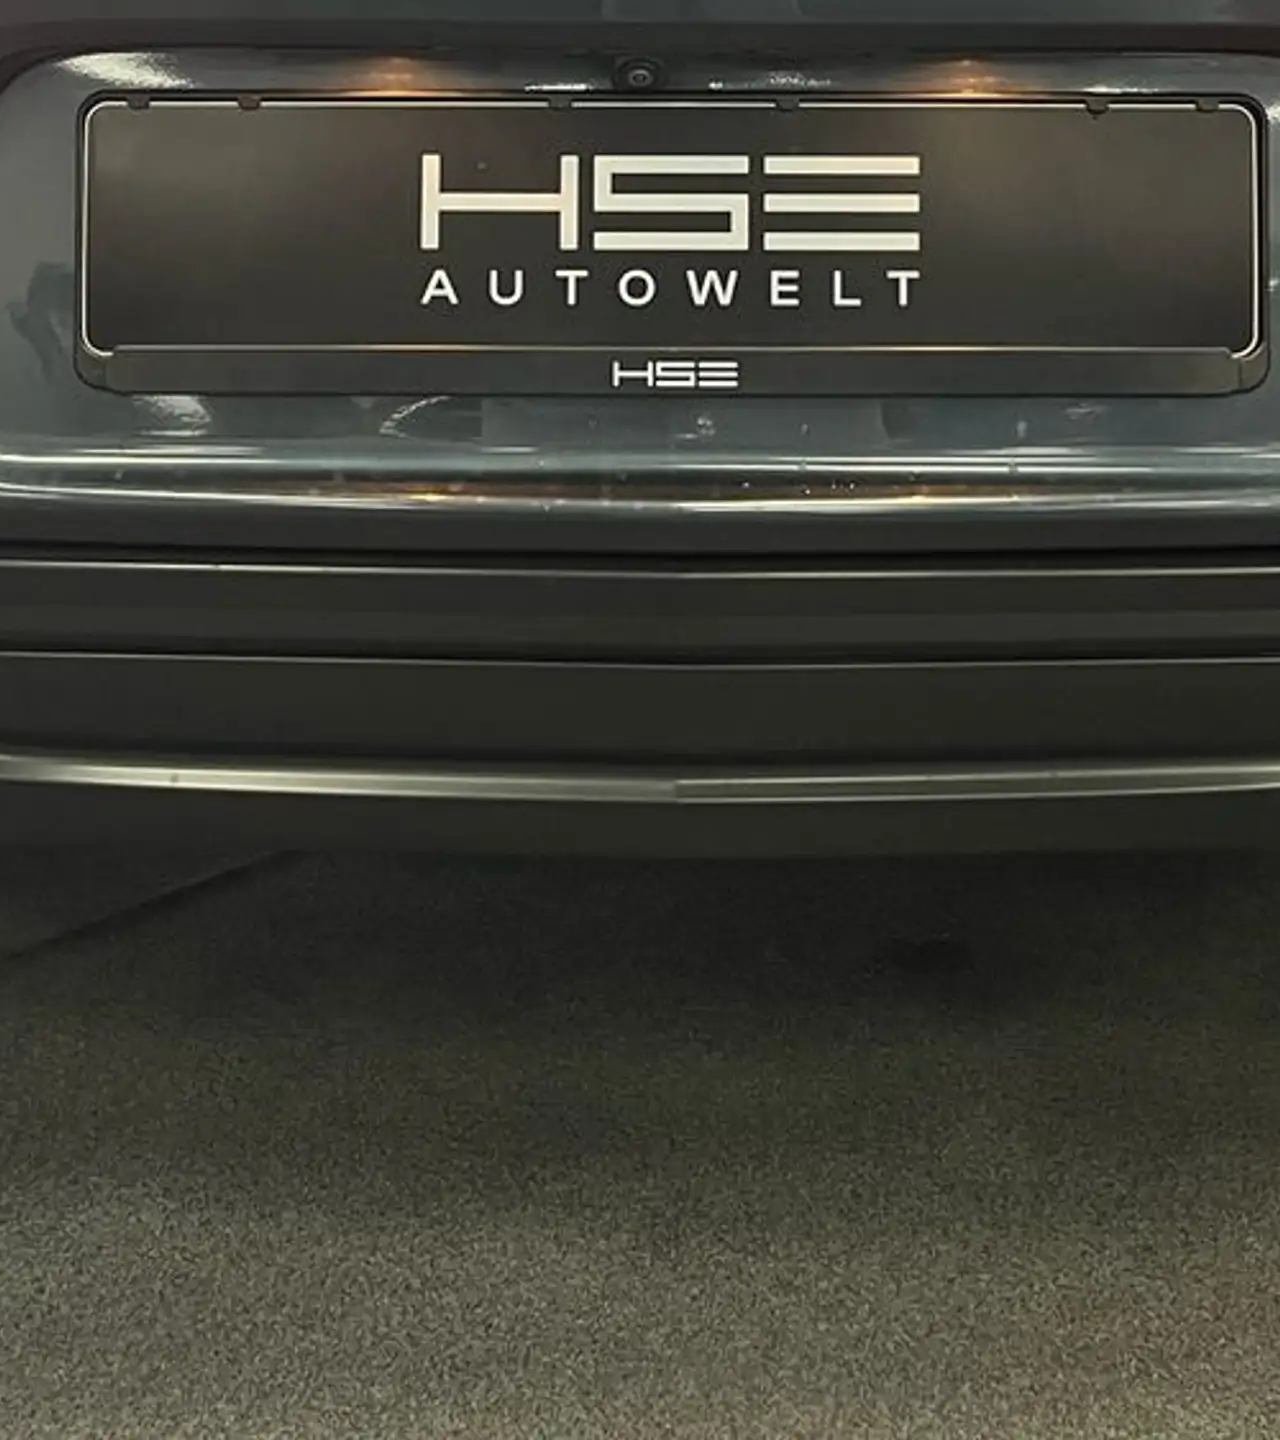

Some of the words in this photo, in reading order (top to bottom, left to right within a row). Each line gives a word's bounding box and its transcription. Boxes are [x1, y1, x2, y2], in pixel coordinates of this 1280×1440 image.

[420, 154, 921, 251] HSE
[421, 269, 920, 307] AUTOWELT
[612, 360, 739, 388] HSE
